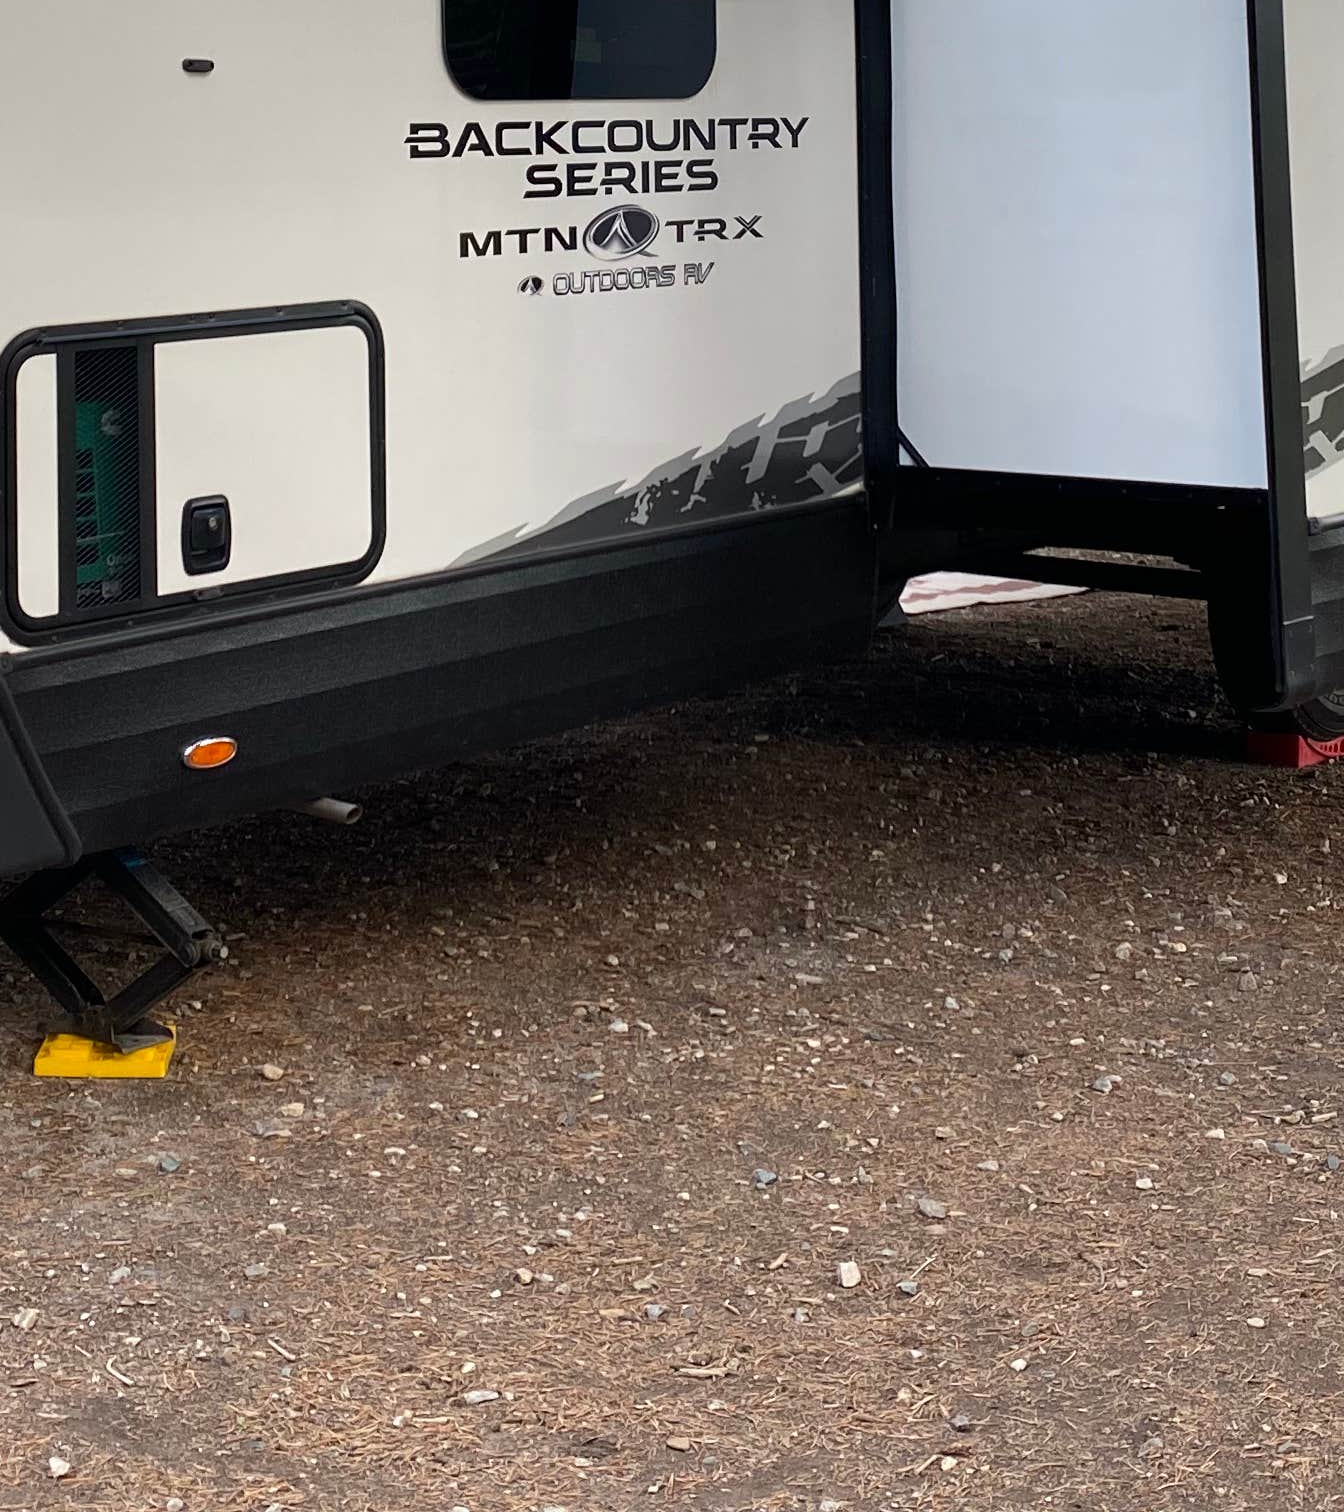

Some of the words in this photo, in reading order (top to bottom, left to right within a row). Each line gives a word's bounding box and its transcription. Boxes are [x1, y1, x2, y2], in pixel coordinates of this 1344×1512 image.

[403, 116, 810, 159] BACKCOUNTRY
[522, 158, 720, 199] SERIES
[458, 225, 578, 258] MTN
[664, 214, 764, 243] TRX
[552, 263, 677, 296] OUTDOORS
[683, 261, 715, 285] RV
